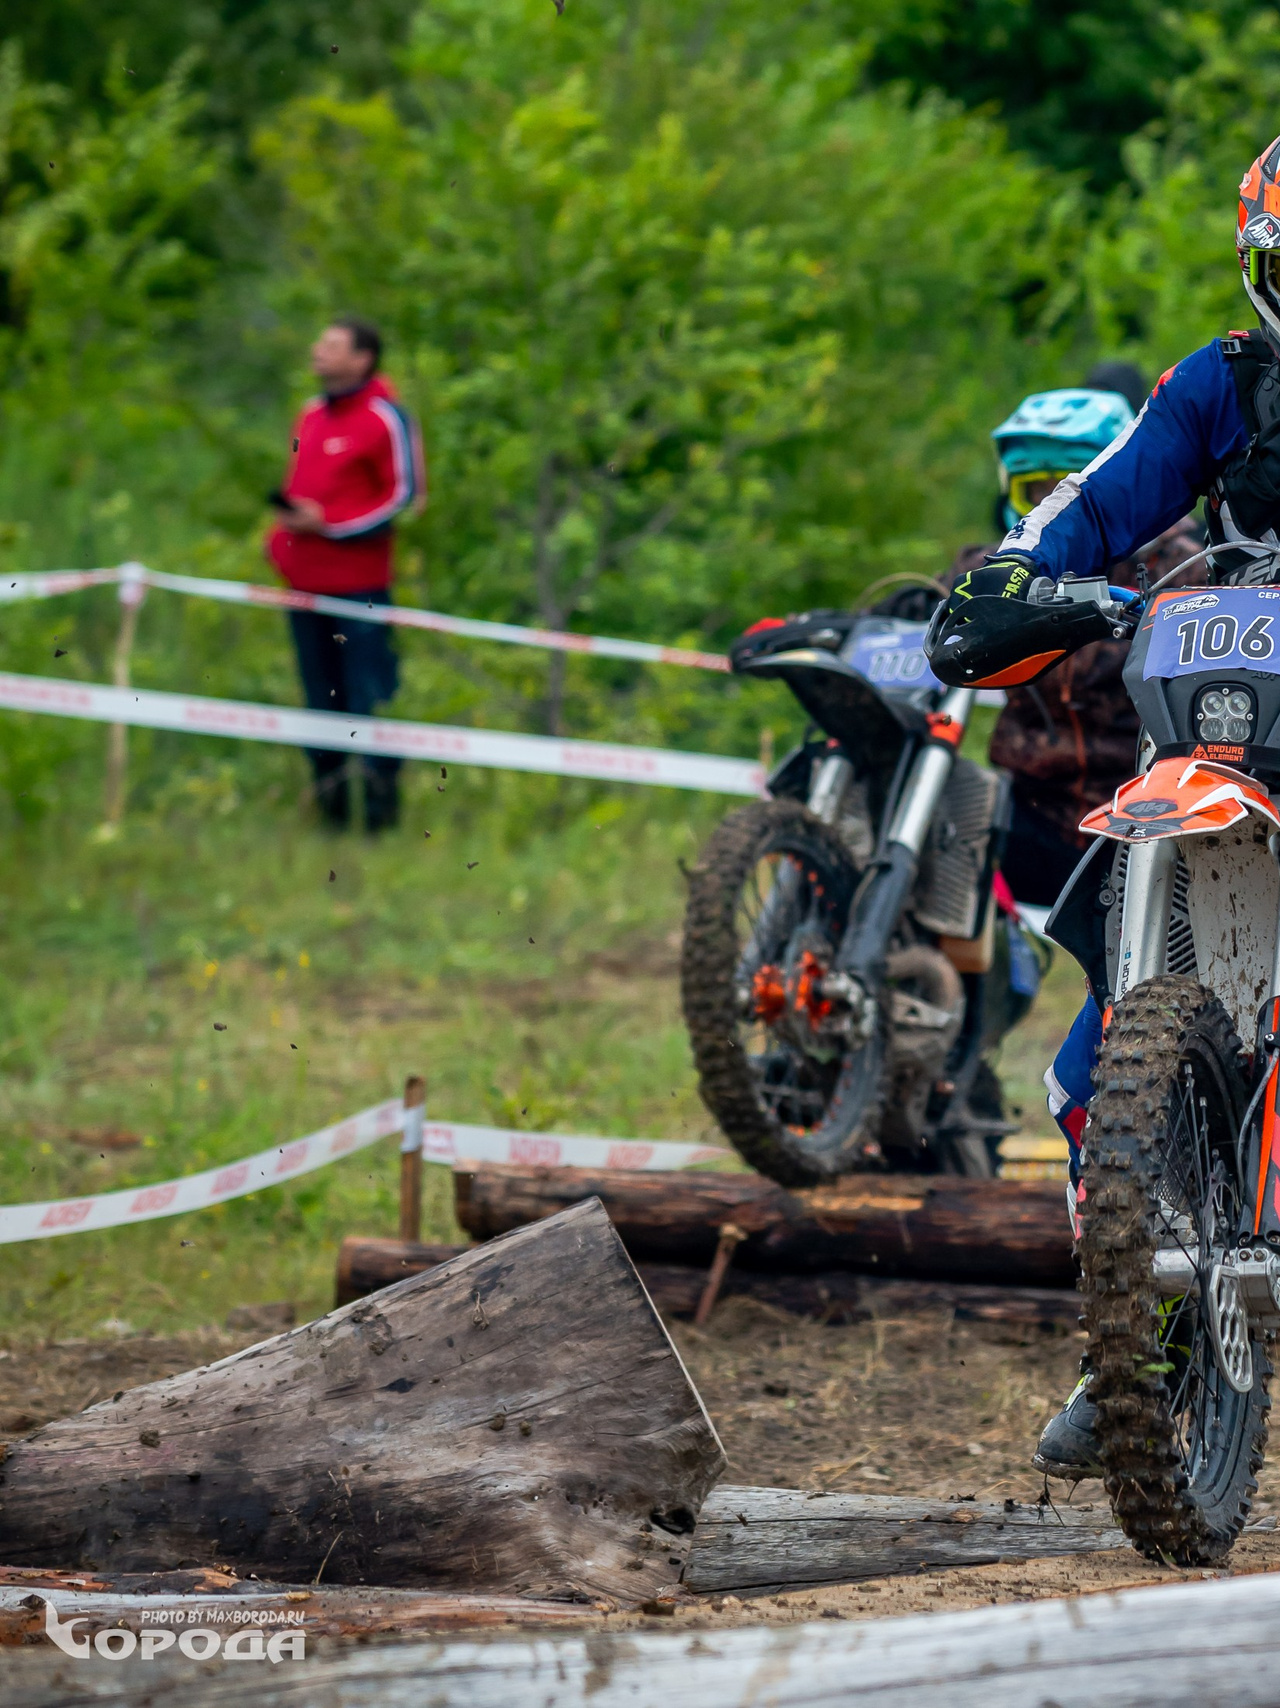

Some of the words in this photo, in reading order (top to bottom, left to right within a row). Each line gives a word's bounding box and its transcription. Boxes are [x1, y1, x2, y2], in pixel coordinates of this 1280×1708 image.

[1248, 218, 1280, 249] Airoh
[1177, 614, 1274, 665] 106
[869, 647, 928, 682] 110
[1194, 751, 1205, 759] E2
[1207, 745, 1244, 755] ENDURO
[1210, 753, 1244, 762] ELEMENT
[1120, 962, 1131, 997] XPLOR
